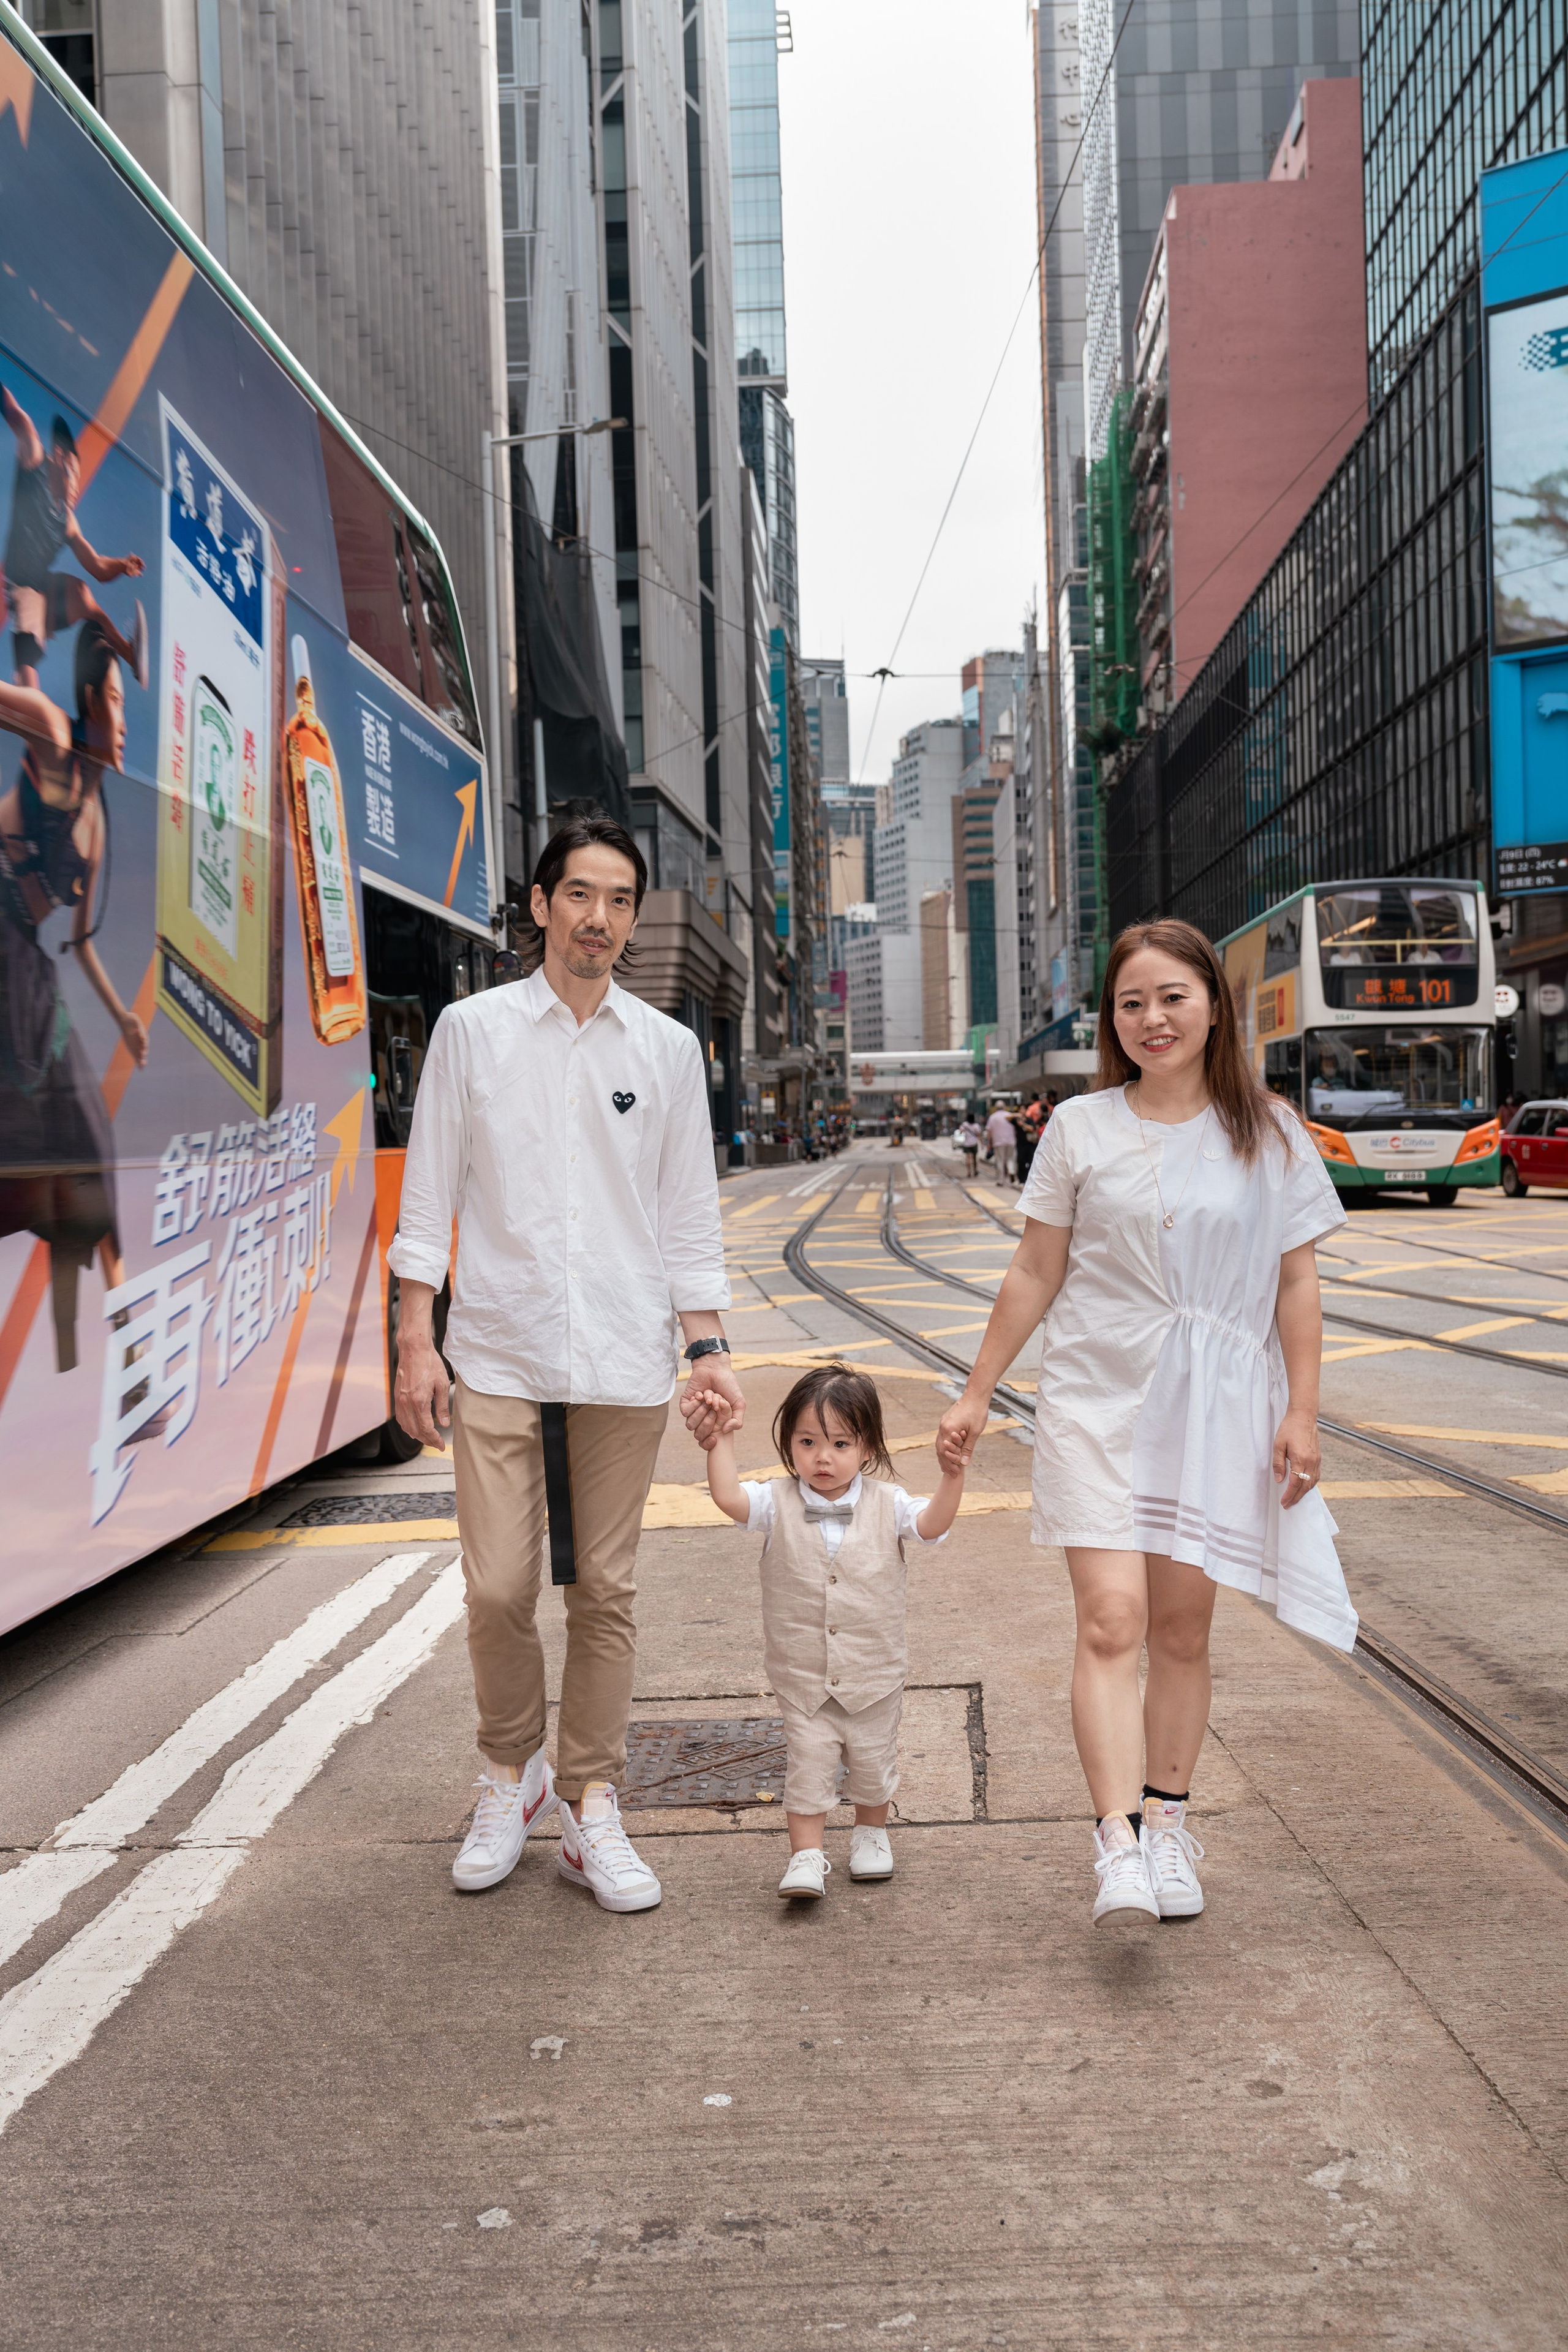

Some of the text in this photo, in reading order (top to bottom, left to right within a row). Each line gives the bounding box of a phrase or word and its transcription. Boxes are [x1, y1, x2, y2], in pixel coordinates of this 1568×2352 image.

[361, 709, 391, 773] 香港
[365, 782, 395, 845] 製造
[168, 962, 205, 1017] WONG
[206, 1001, 223, 1035] TO
[224, 1012, 252, 1069] YICK
[1356, 993, 1415, 1005] Kwun Tong
[1419, 979, 1451, 1003] 101
[152, 1101, 318, 1247] 舒筋活絡
[1402, 1137, 1436, 1148] Citybus
